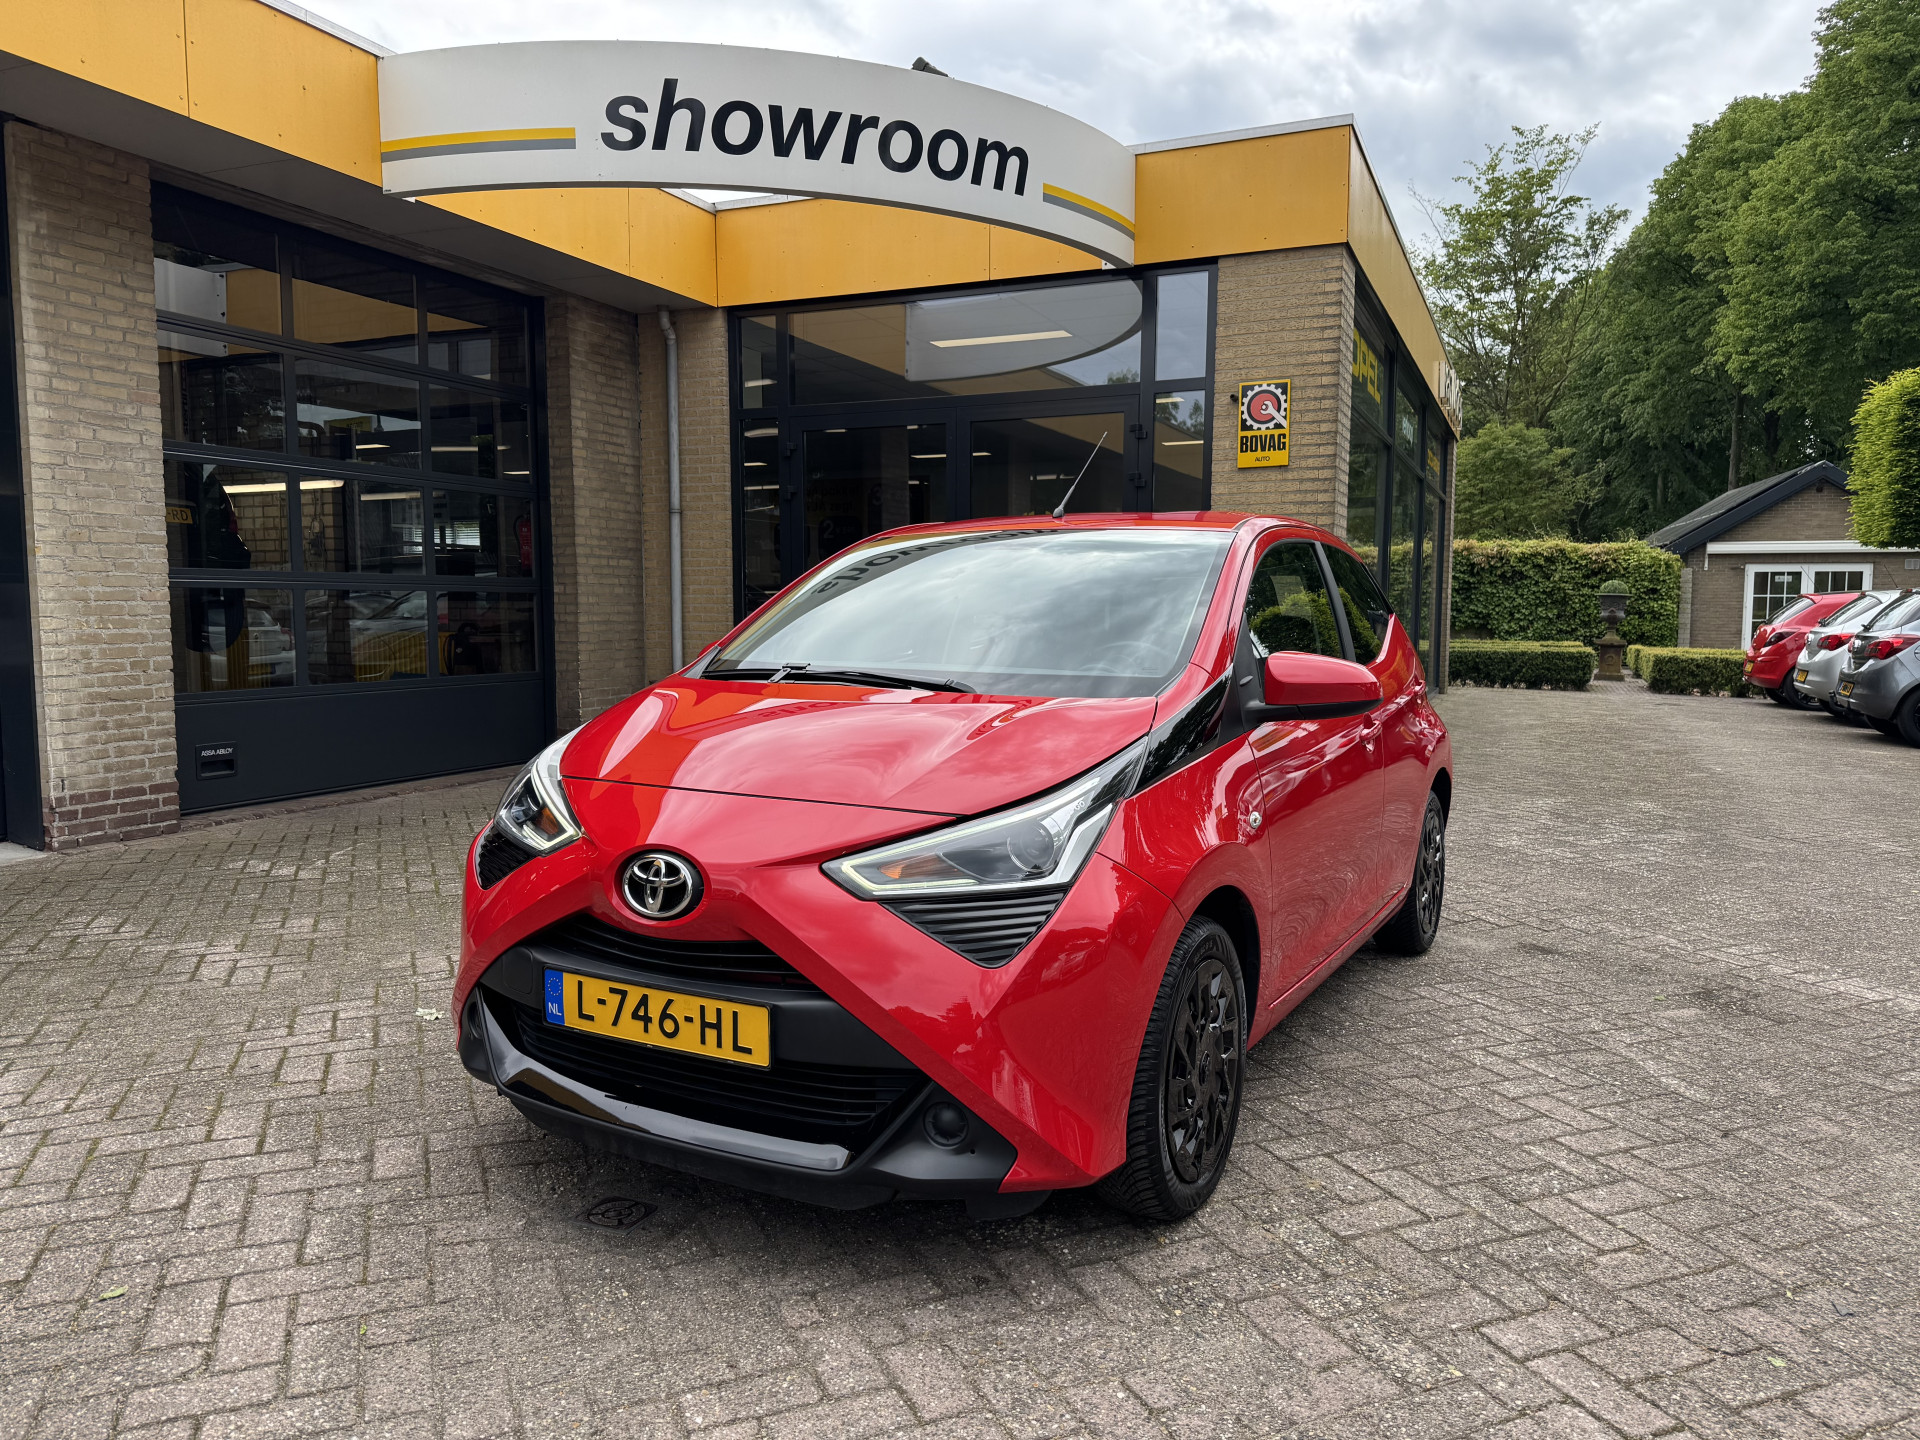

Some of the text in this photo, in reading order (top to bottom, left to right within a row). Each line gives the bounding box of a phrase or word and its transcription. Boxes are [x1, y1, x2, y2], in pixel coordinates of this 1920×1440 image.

[600, 77, 1030, 196] showroom
[1352, 327, 1381, 404] OPEL
[1239, 433, 1287, 453] BOVAG
[201, 747, 234, 757] ASSA ABLOY
[548, 1001, 562, 1016] NL
[576, 979, 753, 1056] L-746-HL
